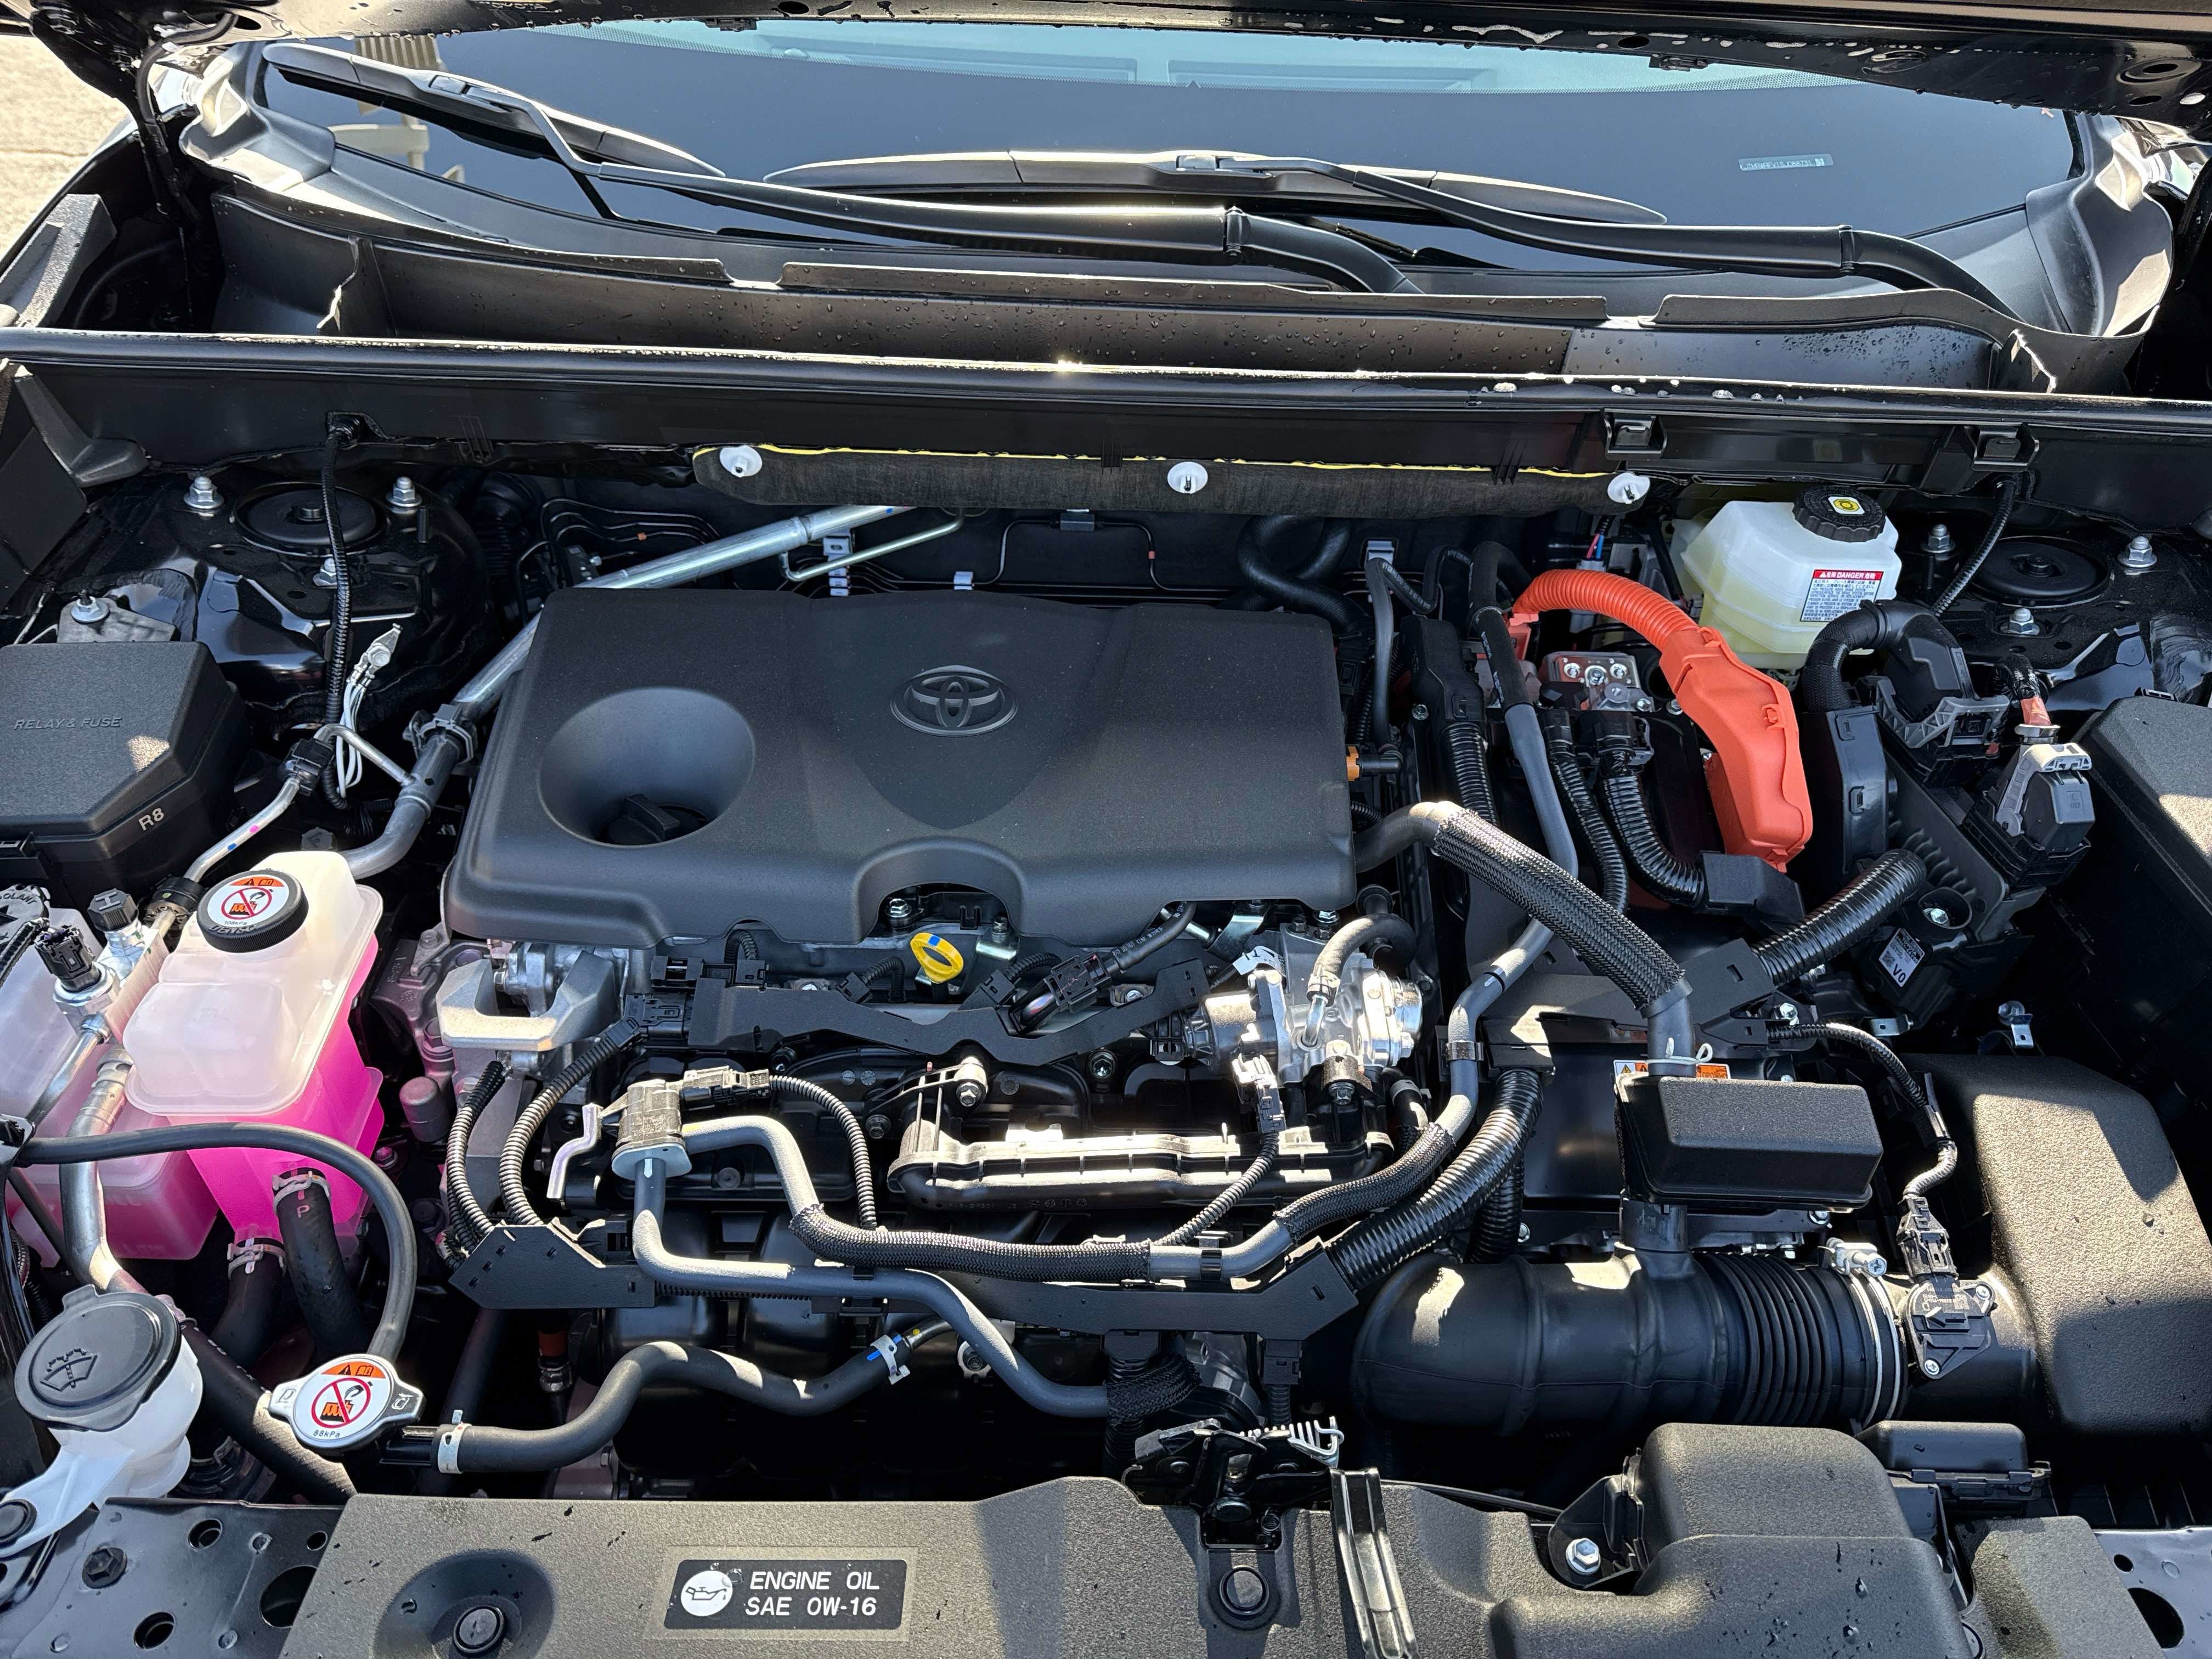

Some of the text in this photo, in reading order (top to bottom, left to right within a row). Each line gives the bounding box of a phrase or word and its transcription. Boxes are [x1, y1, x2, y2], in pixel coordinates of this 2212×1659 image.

[13, 717, 122, 730] RELAY & FUSE
[138, 808, 165, 831] R8
[296, 1205, 309, 1218] P
[313, 1429, 340, 1438] 88kPa
[750, 1571, 879, 1590] ENGINE OIL
[745, 1597, 877, 1616] SAE 0W-16
